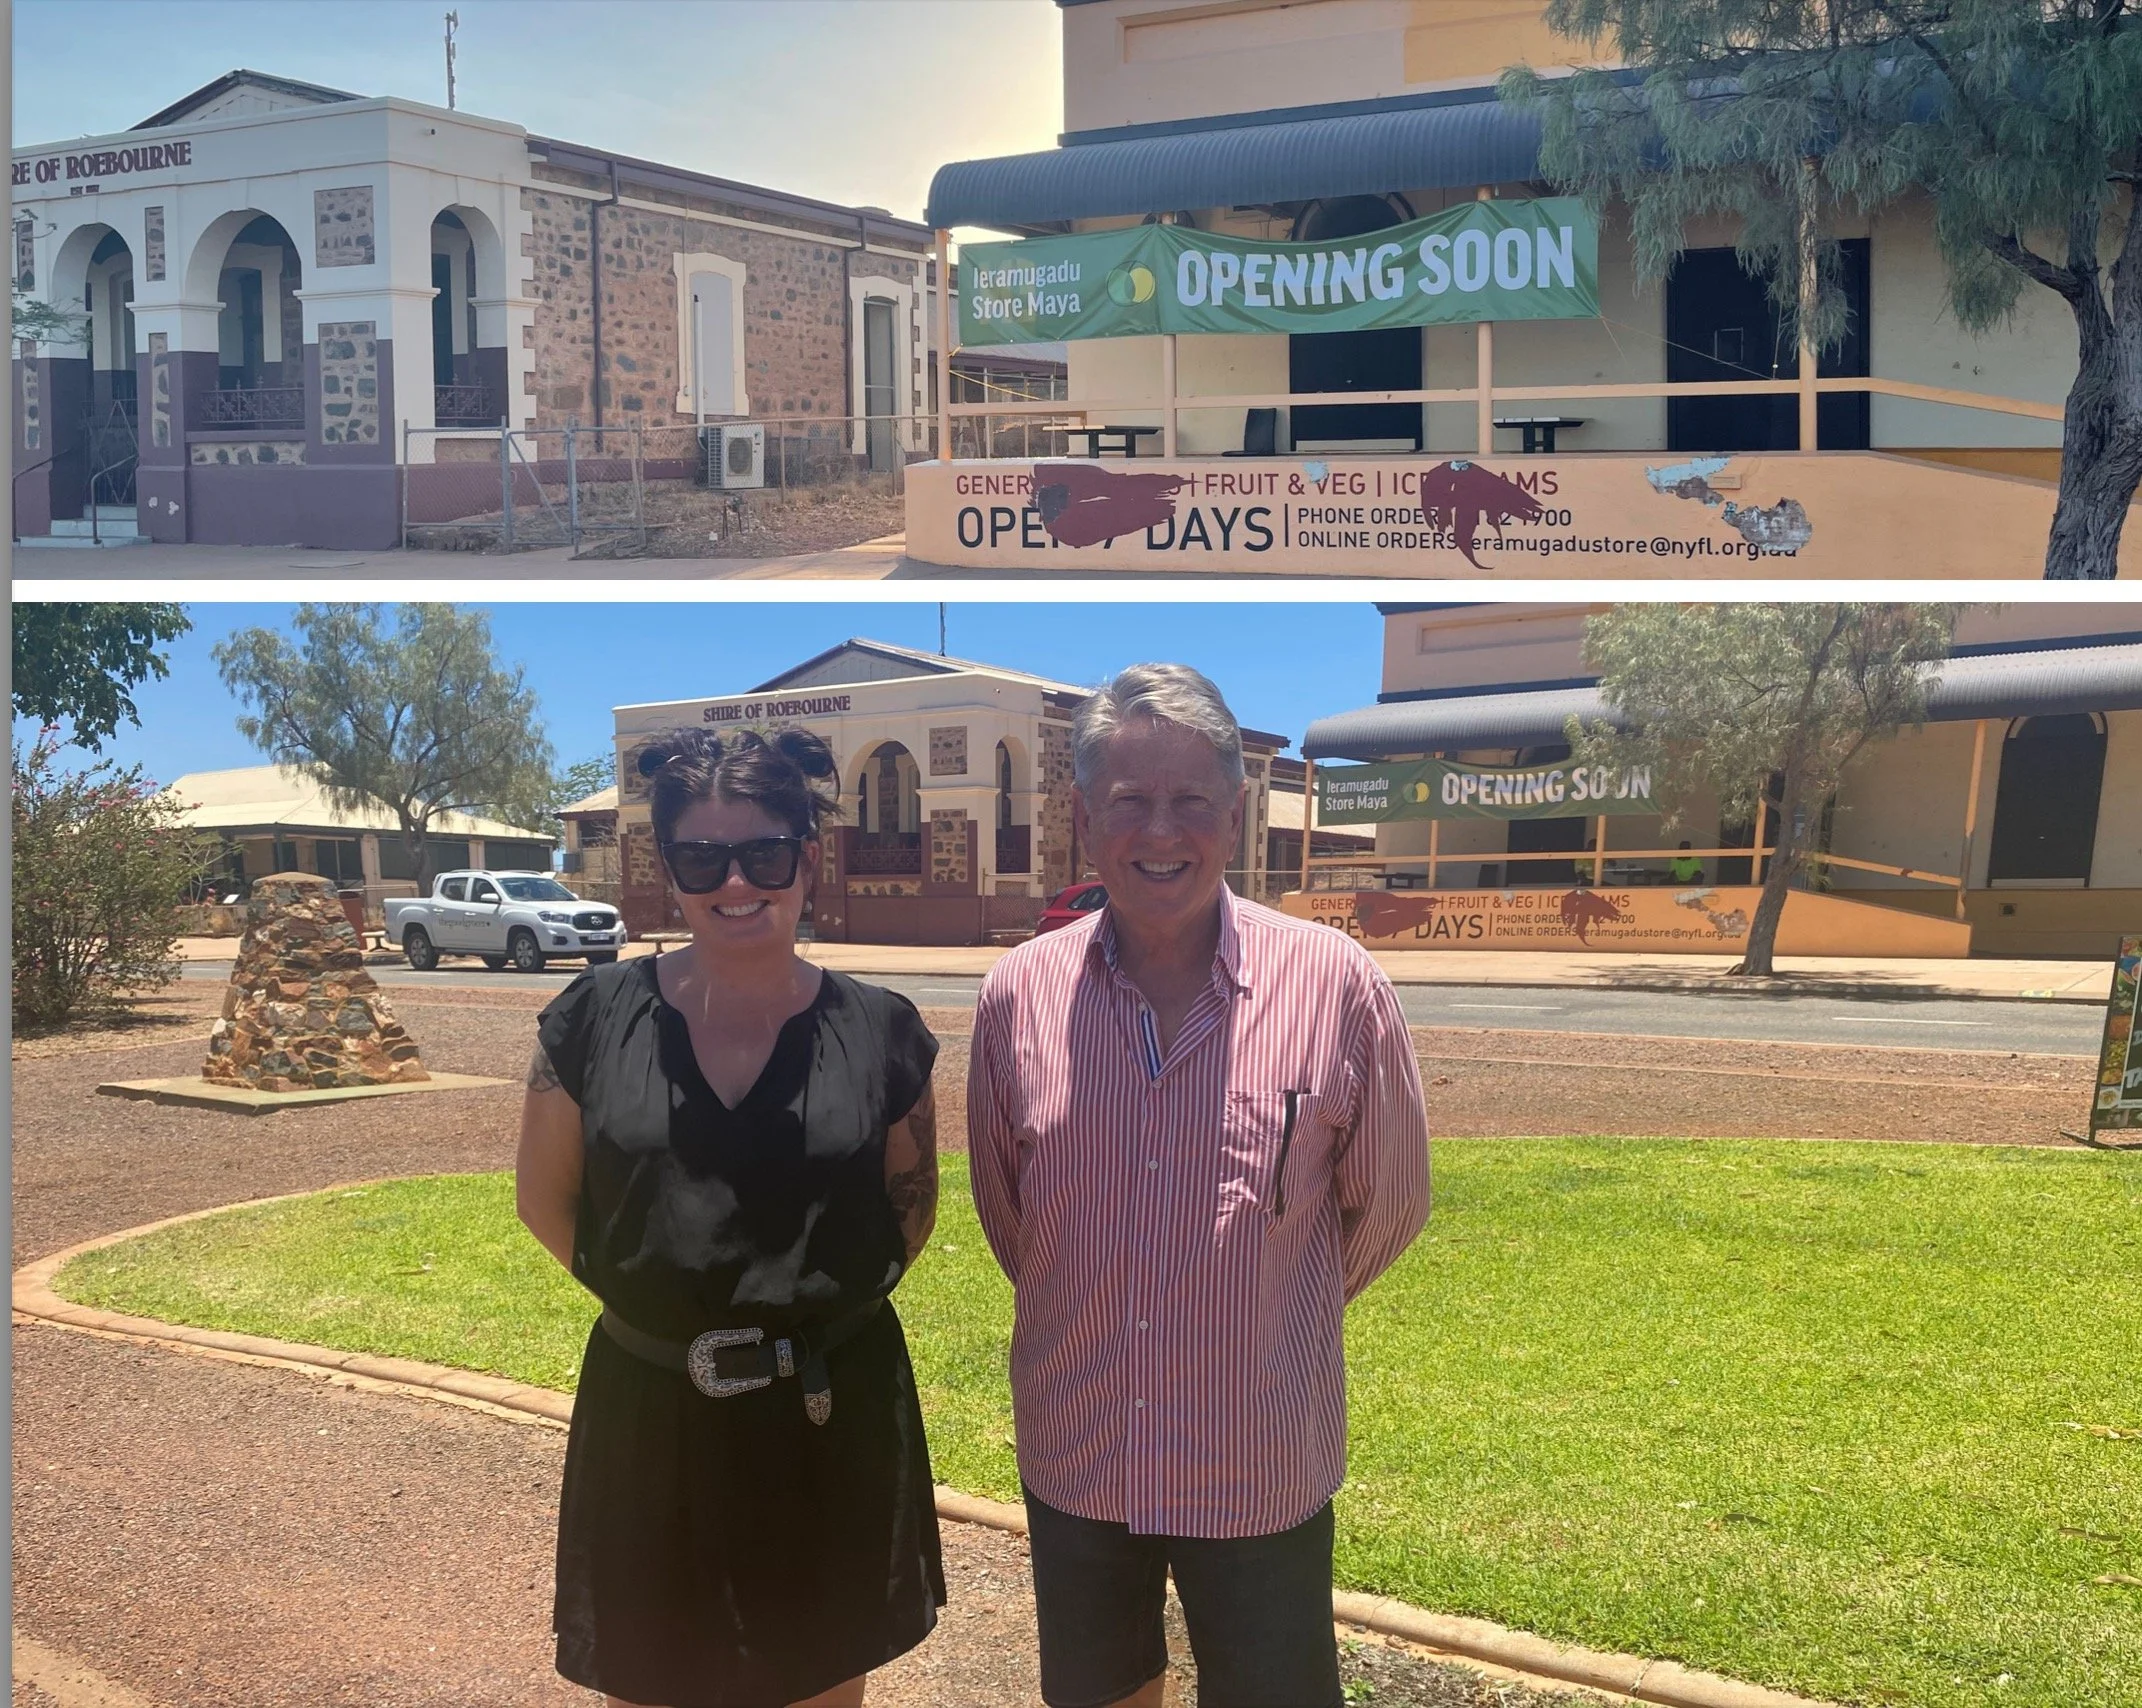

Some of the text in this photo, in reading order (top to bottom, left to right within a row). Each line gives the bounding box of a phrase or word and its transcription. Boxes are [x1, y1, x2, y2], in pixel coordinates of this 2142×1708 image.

[35, 157, 61, 183] OF
[66, 141, 192, 179] ROEBOURNE
[972, 259, 1081, 289] Ieramugadu
[1176, 226, 1576, 308] OPENING SOON
[971, 291, 1082, 320] Store Maya
[956, 474, 1031, 496] GENER
[1205, 473, 1279, 496] FRUIT
[1288, 473, 1305, 496] &
[1312, 472, 1366, 496] VEG
[957, 506, 1060, 549] OPE
[1298, 507, 1365, 525] PHONE
[1298, 530, 1371, 548] ONLINE
[703, 695, 851, 722] SHIRE OF ROEBOURNE
[1326, 777, 1390, 793] Ieramugadu
[1441, 770, 1565, 806] OPENING
[1325, 795, 1388, 811] Store Maya
[1311, 898, 1353, 910] GENER
[1448, 896, 1489, 909] FRUIT
[1492, 896, 1501, 909] &
[1496, 914, 1532, 924] PHONE
[1495, 927, 1534, 937] ONLINE
